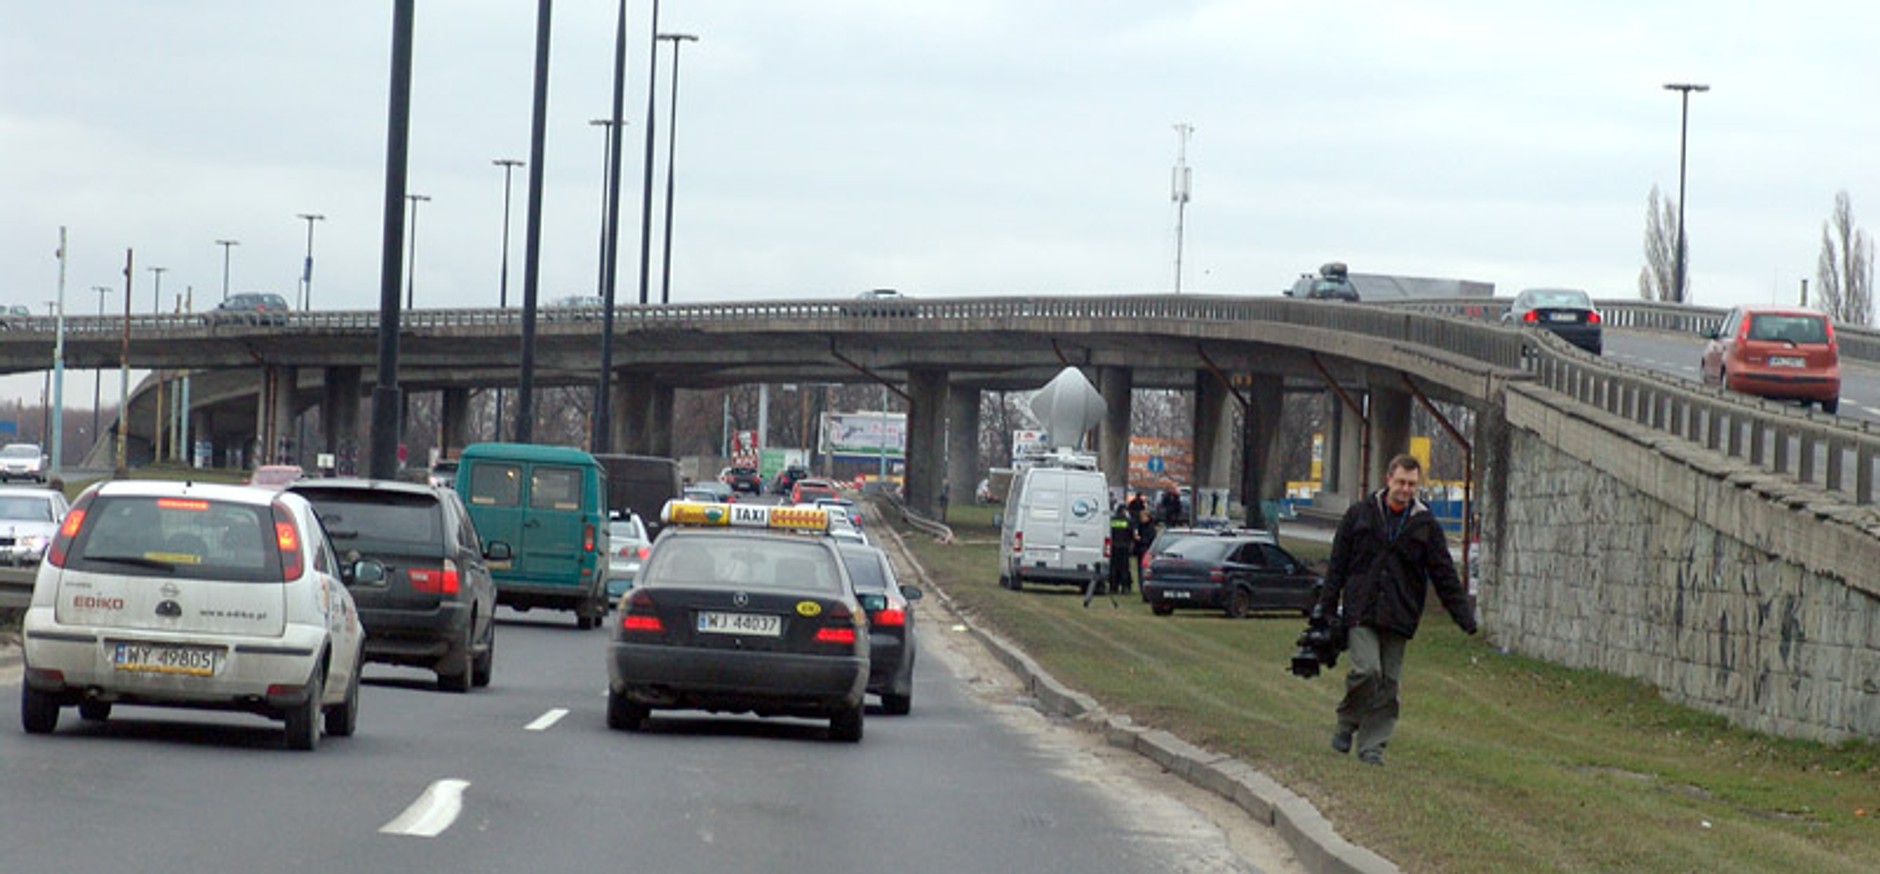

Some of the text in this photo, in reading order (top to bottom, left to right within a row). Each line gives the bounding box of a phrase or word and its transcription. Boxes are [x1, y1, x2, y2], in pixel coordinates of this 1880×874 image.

[735, 507, 765, 521] TAXI
[708, 613, 777, 631] WJ 44037
[127, 645, 211, 669] WY 49805
